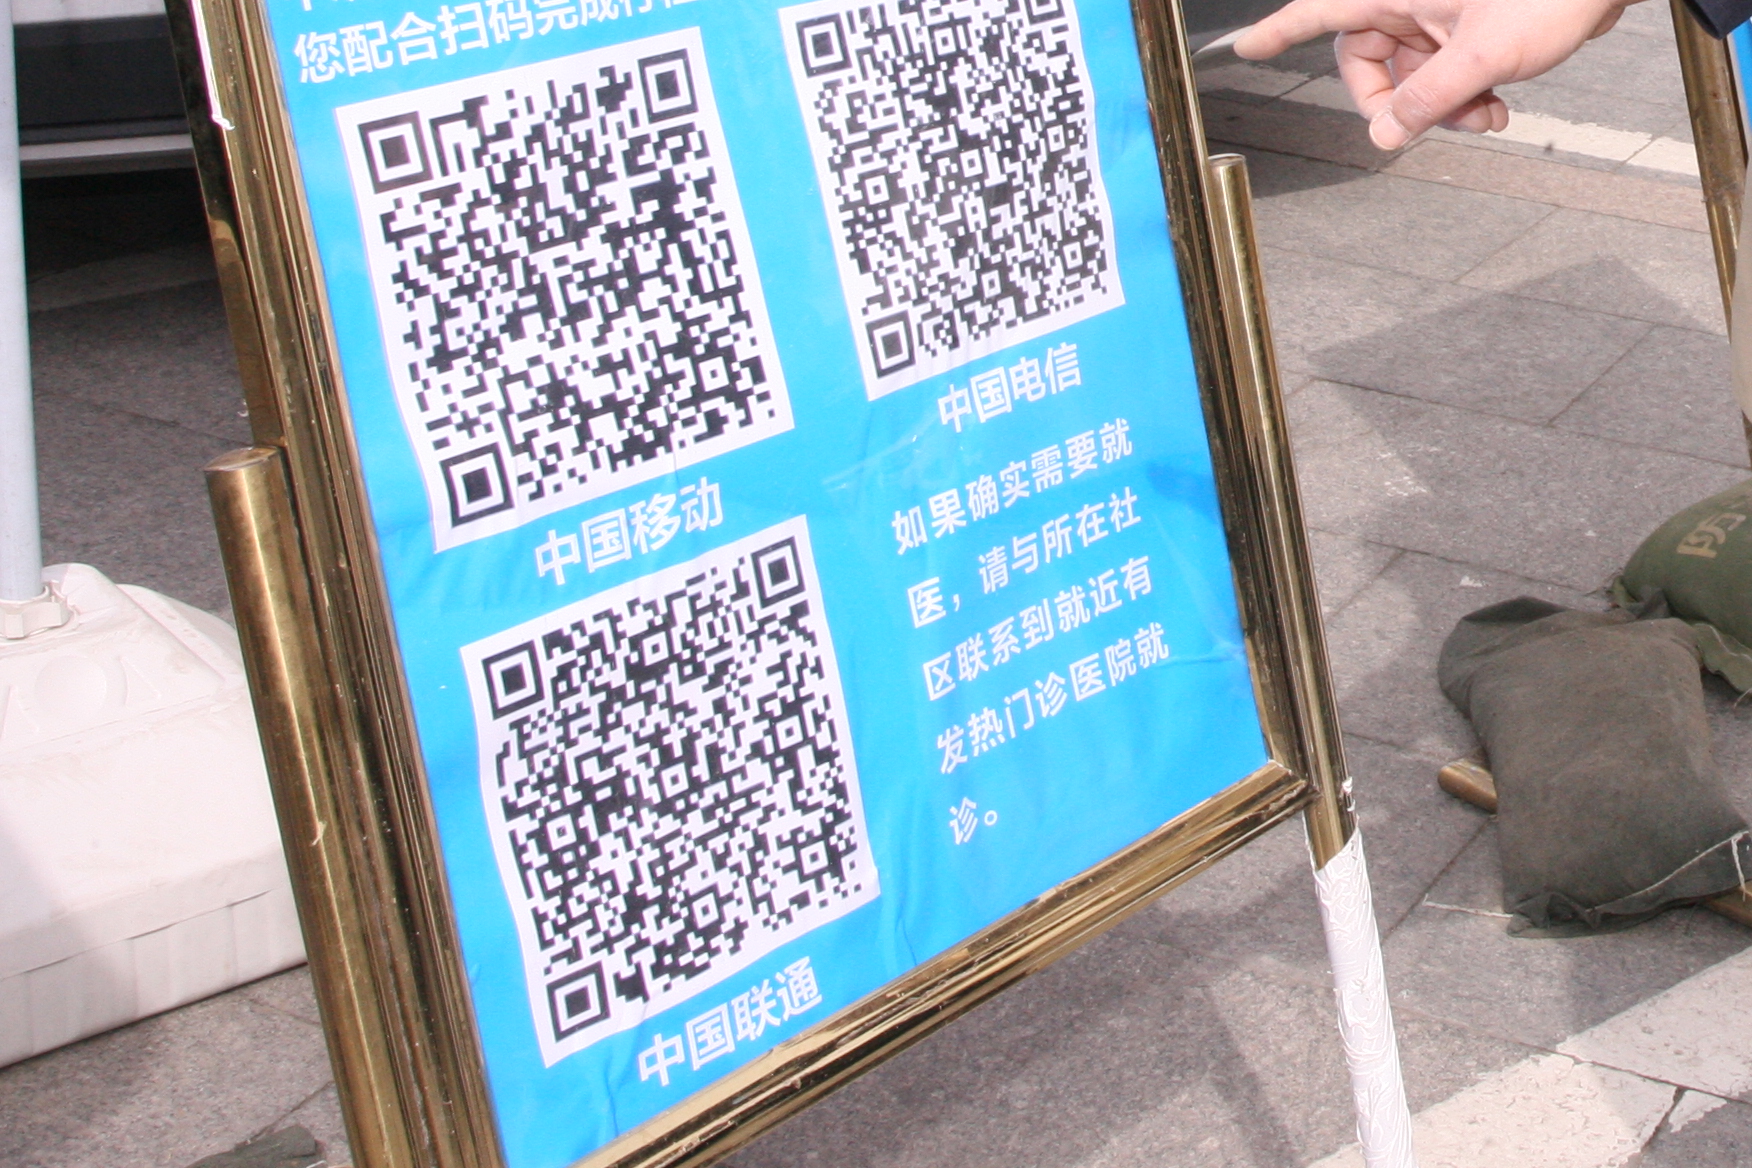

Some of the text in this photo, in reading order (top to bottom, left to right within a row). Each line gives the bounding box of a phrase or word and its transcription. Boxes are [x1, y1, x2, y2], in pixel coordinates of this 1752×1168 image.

[936, 342, 1083, 435] 中国电信
[533, 477, 724, 587] 中国移动
[890, 418, 1134, 557] 如果确实需要就
[907, 486, 1142, 629] 医，请与所在社
[923, 554, 1156, 702] 区联系到就近有
[936, 622, 1172, 775] 发热门诊医院就
[948, 795, 999, 848] 诊。
[636, 955, 824, 1088] 中国联通
